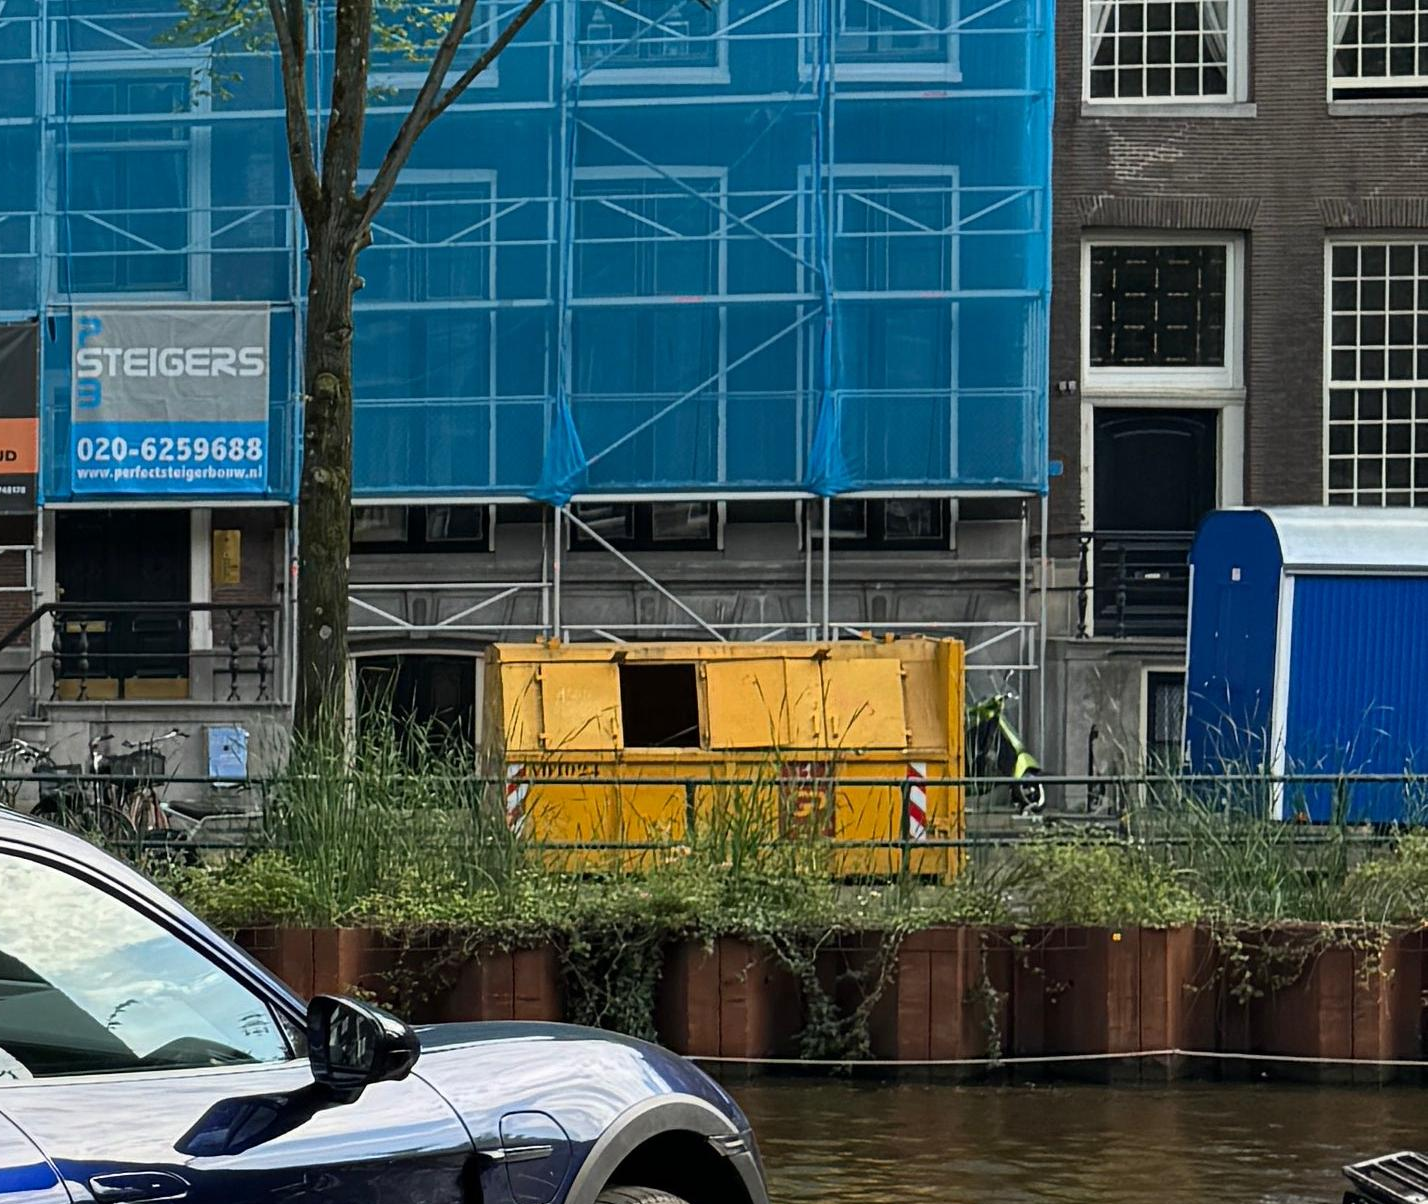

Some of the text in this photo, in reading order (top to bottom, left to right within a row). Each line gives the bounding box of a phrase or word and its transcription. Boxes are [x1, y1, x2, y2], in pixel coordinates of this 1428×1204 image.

[76, 347, 265, 378] STEIGERS
[76, 436, 264, 462] 020-6259688
[76, 465, 263, 482] www.perfectsteigerbouw.nl
